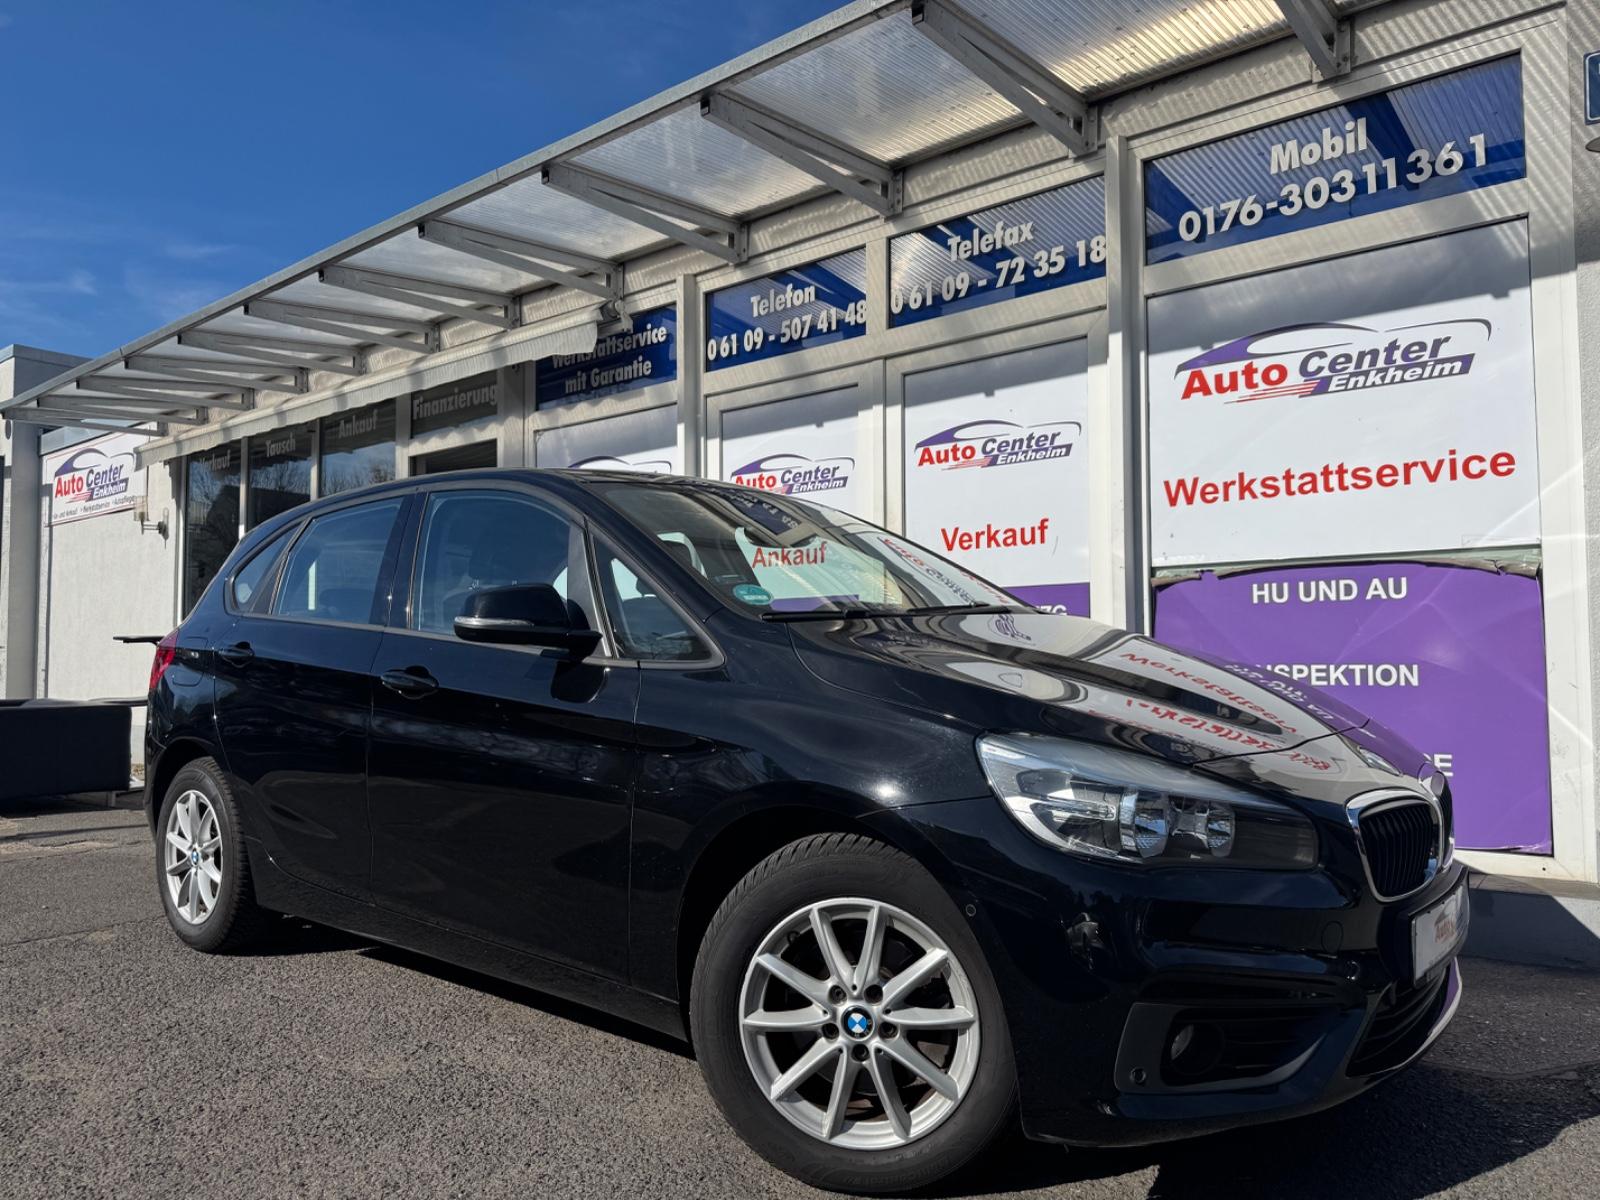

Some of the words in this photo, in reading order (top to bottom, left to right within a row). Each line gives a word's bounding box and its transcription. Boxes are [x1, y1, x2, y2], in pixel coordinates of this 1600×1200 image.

[1270, 117, 1367, 175] Mobil
[947, 221, 1035, 262] Telefax
[890, 289, 904, 315] 0
[909, 280, 934, 311] 61
[942, 272, 970, 301] 09
[995, 256, 1026, 289] 72
[1033, 245, 1067, 278] 35
[1076, 235, 1106, 268] 18
[750, 283, 816, 318] Telefon
[707, 338, 717, 361] 0
[720, 333, 738, 361] 61
[743, 327, 764, 353] 09
[780, 313, 813, 344] 507
[817, 307, 838, 333] 41
[844, 300, 867, 326] 48
[565, 371, 586, 394] mit
[590, 355, 652, 387] Garantie
[1181, 361, 1288, 400] Auto
[1299, 336, 1452, 379] Center
[1327, 357, 1462, 392] Enkheim
[412, 382, 498, 421] Finanzierung
[338, 408, 379, 439] Ankauf
[265, 431, 296, 458] Tausch
[918, 442, 976, 467] Auto
[981, 431, 1062, 455] Center
[996, 446, 1067, 465] Enkheim
[55, 473, 84, 498] Auto
[86, 464, 124, 488] Center
[93, 481, 126, 497] Enkheim
[781, 465, 840, 484] Center
[791, 479, 844, 493] Enkheim
[1163, 448, 1516, 507] Werkstattservice
[940, 518, 1049, 552] Verkauf
[752, 540, 828, 568] Ankauf
[1252, 582, 1289, 604] HU
[1298, 579, 1358, 602] UND
[1365, 577, 1408, 600] AU
[1256, 664, 1419, 687] SPEKTION
